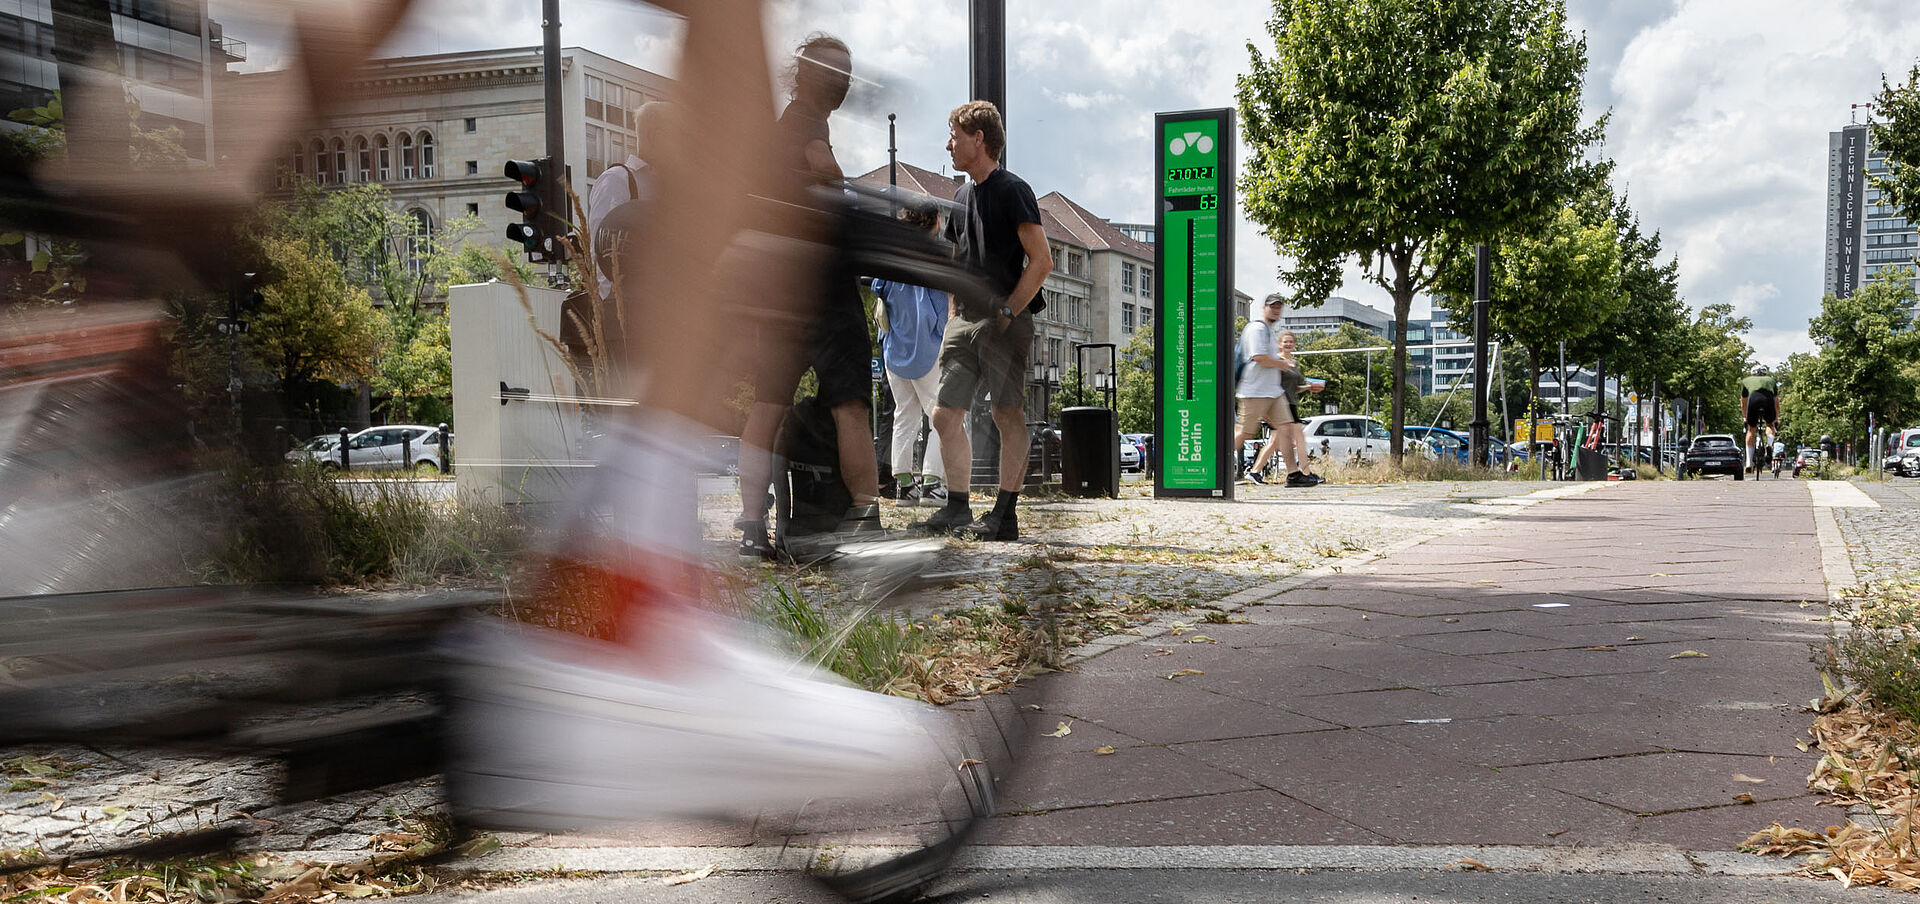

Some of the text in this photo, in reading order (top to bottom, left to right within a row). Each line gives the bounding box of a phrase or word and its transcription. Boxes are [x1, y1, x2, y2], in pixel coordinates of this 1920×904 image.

[1168, 167, 1215, 181] 27.07.21
[1846, 136, 1856, 229] TECHNISCHE
[1200, 194, 1218, 210] 63
[1176, 301, 1185, 401] Fahrräder dieses Jahr
[1178, 409, 1189, 461] Fahrrad
[1191, 423, 1202, 461] Berlin
